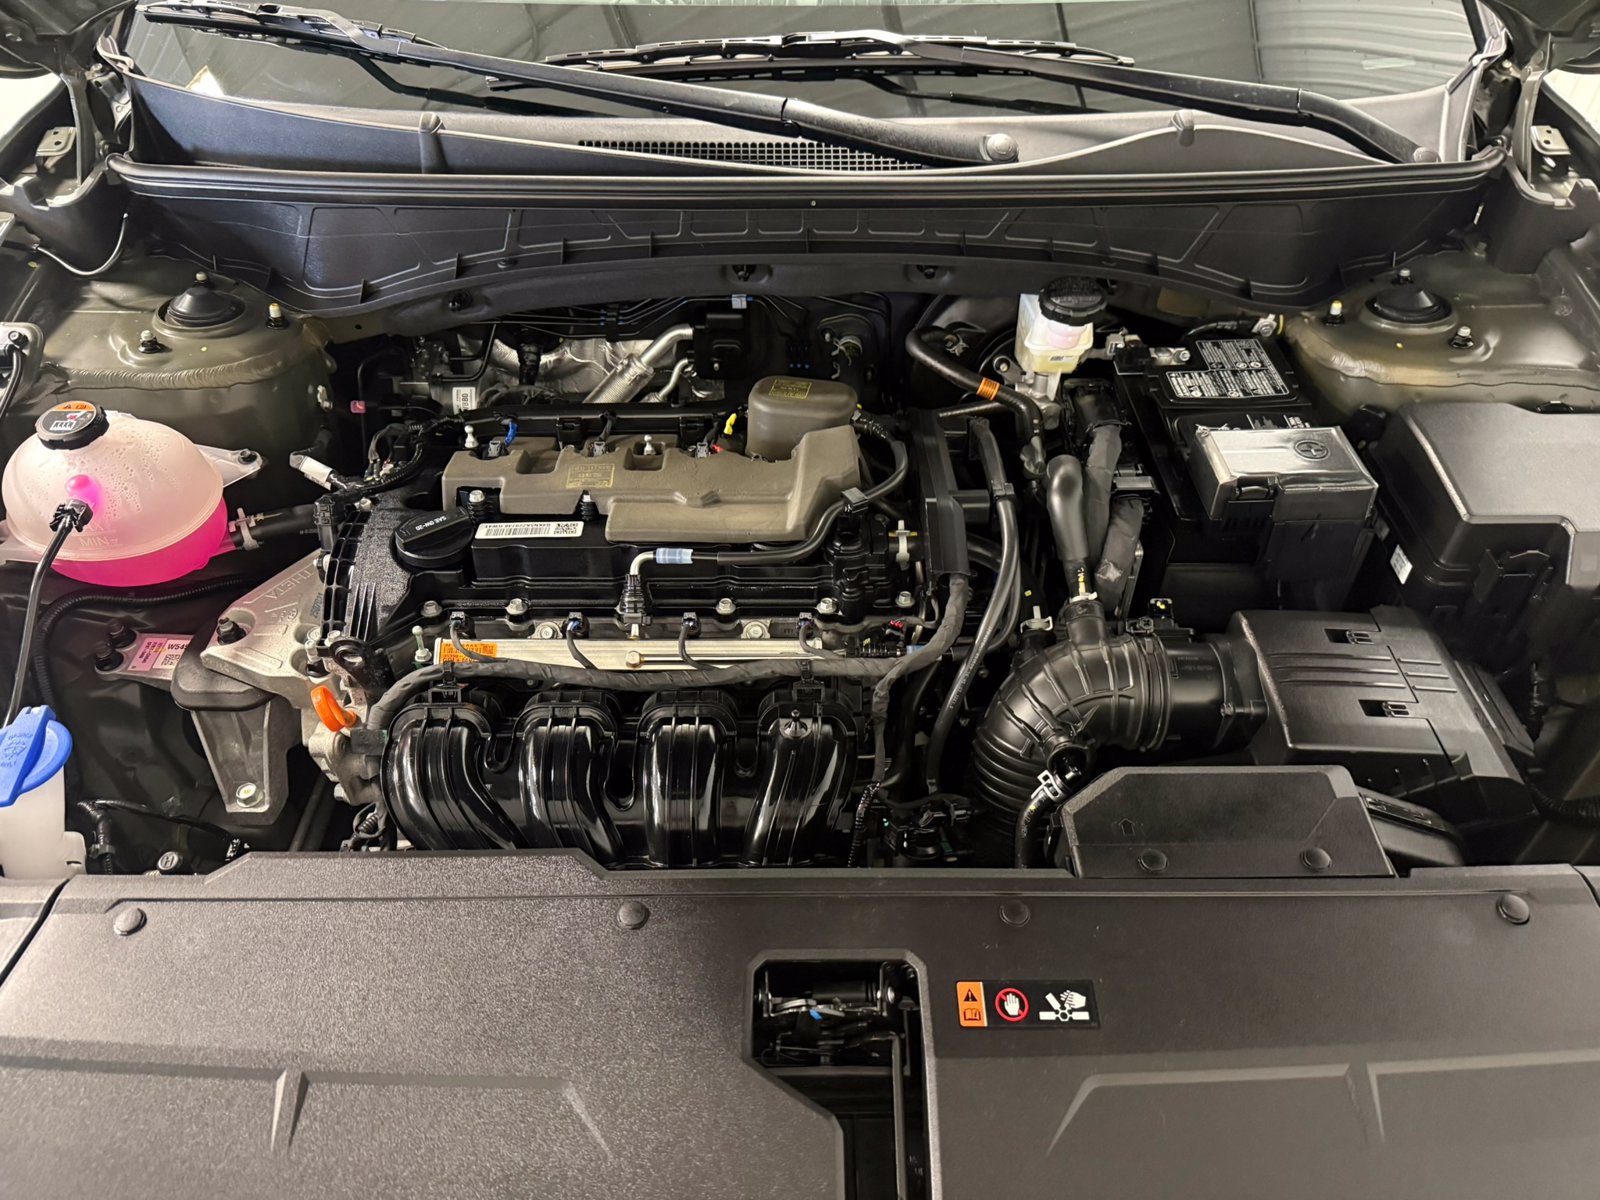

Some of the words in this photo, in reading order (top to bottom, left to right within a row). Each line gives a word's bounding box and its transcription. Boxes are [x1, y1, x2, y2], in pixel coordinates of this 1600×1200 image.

[415, 520, 435, 531] 0W-20
[434, 515, 447, 524] SAE
[78, 535, 111, 548] MIN
[264, 568, 314, 599] THETA
